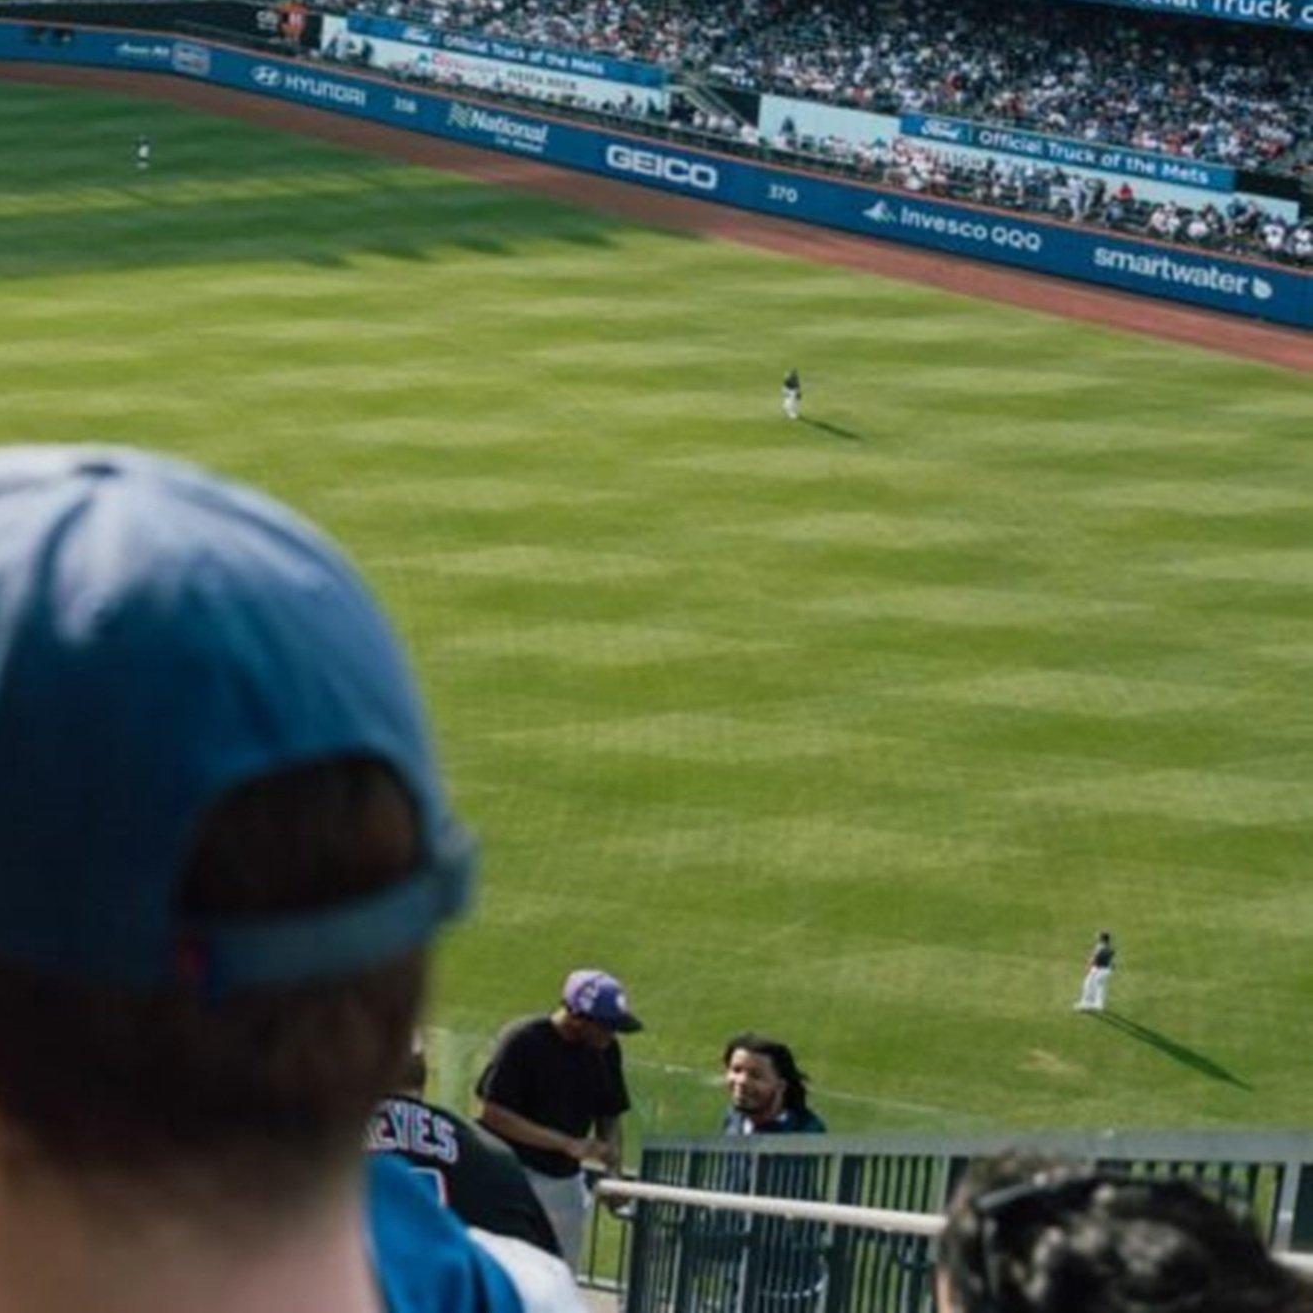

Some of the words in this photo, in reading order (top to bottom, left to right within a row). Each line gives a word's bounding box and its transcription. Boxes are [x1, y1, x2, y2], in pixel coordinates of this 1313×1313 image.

[284, 73, 366, 107] HYUNDAI
[472, 110, 548, 142] National
[606, 144, 718, 189] GEICO
[979, 130, 1043, 153] Official
[1049, 141, 1095, 163] Truck
[1101, 148, 1122, 167] of
[1126, 154, 1156, 174] the
[1161, 162, 1209, 185] Mets
[900, 205, 987, 241] Invesco
[991, 225, 1041, 253] QQQ
[1094, 246, 1249, 298] smartwater
